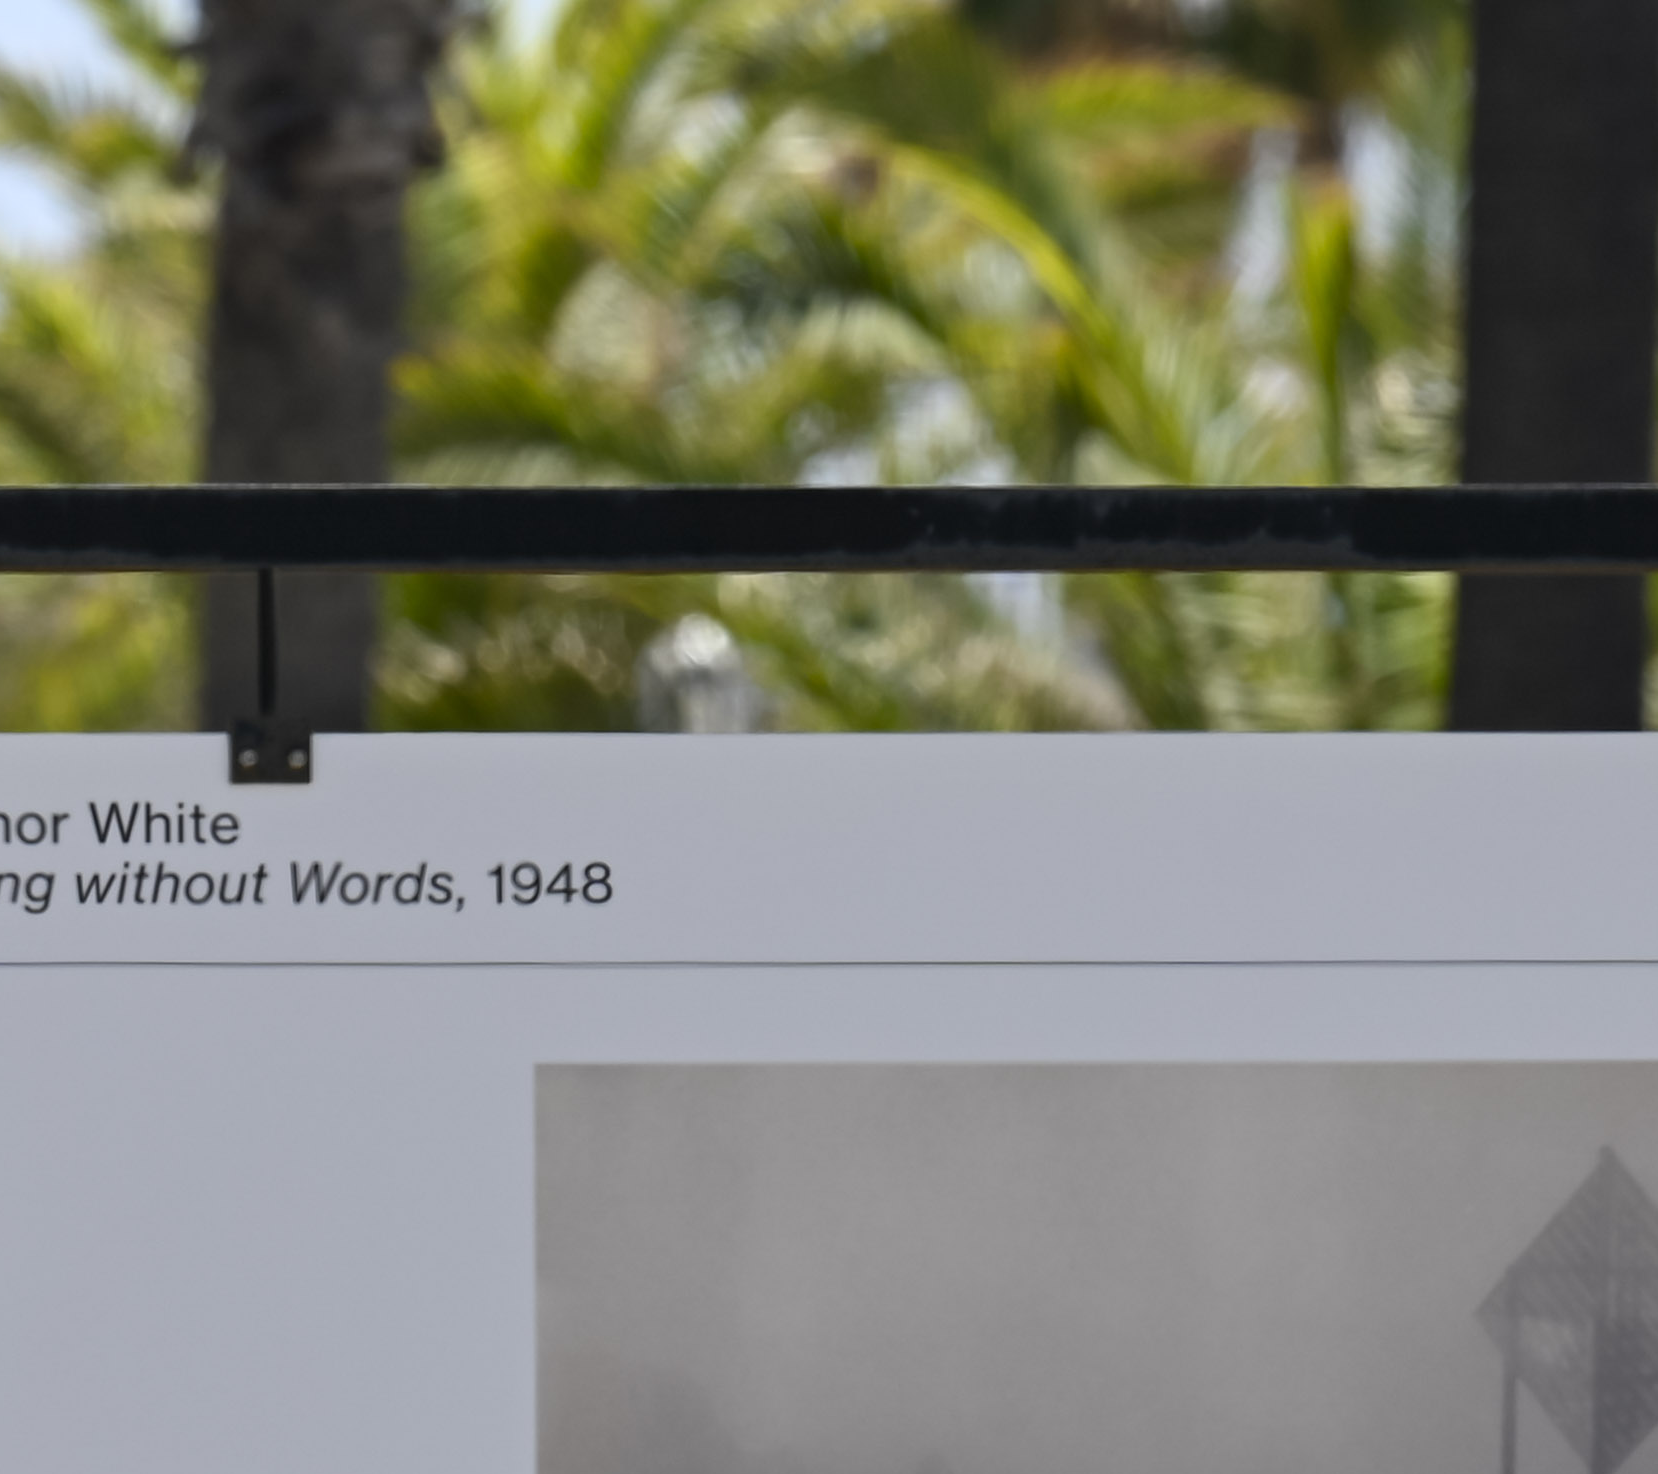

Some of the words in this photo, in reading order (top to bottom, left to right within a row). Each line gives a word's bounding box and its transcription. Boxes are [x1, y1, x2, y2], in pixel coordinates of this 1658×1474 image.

[88, 800, 241, 847] White
[75, 860, 269, 906] without
[290, 860, 466, 914] Words,
[488, 860, 613, 906] 1948
